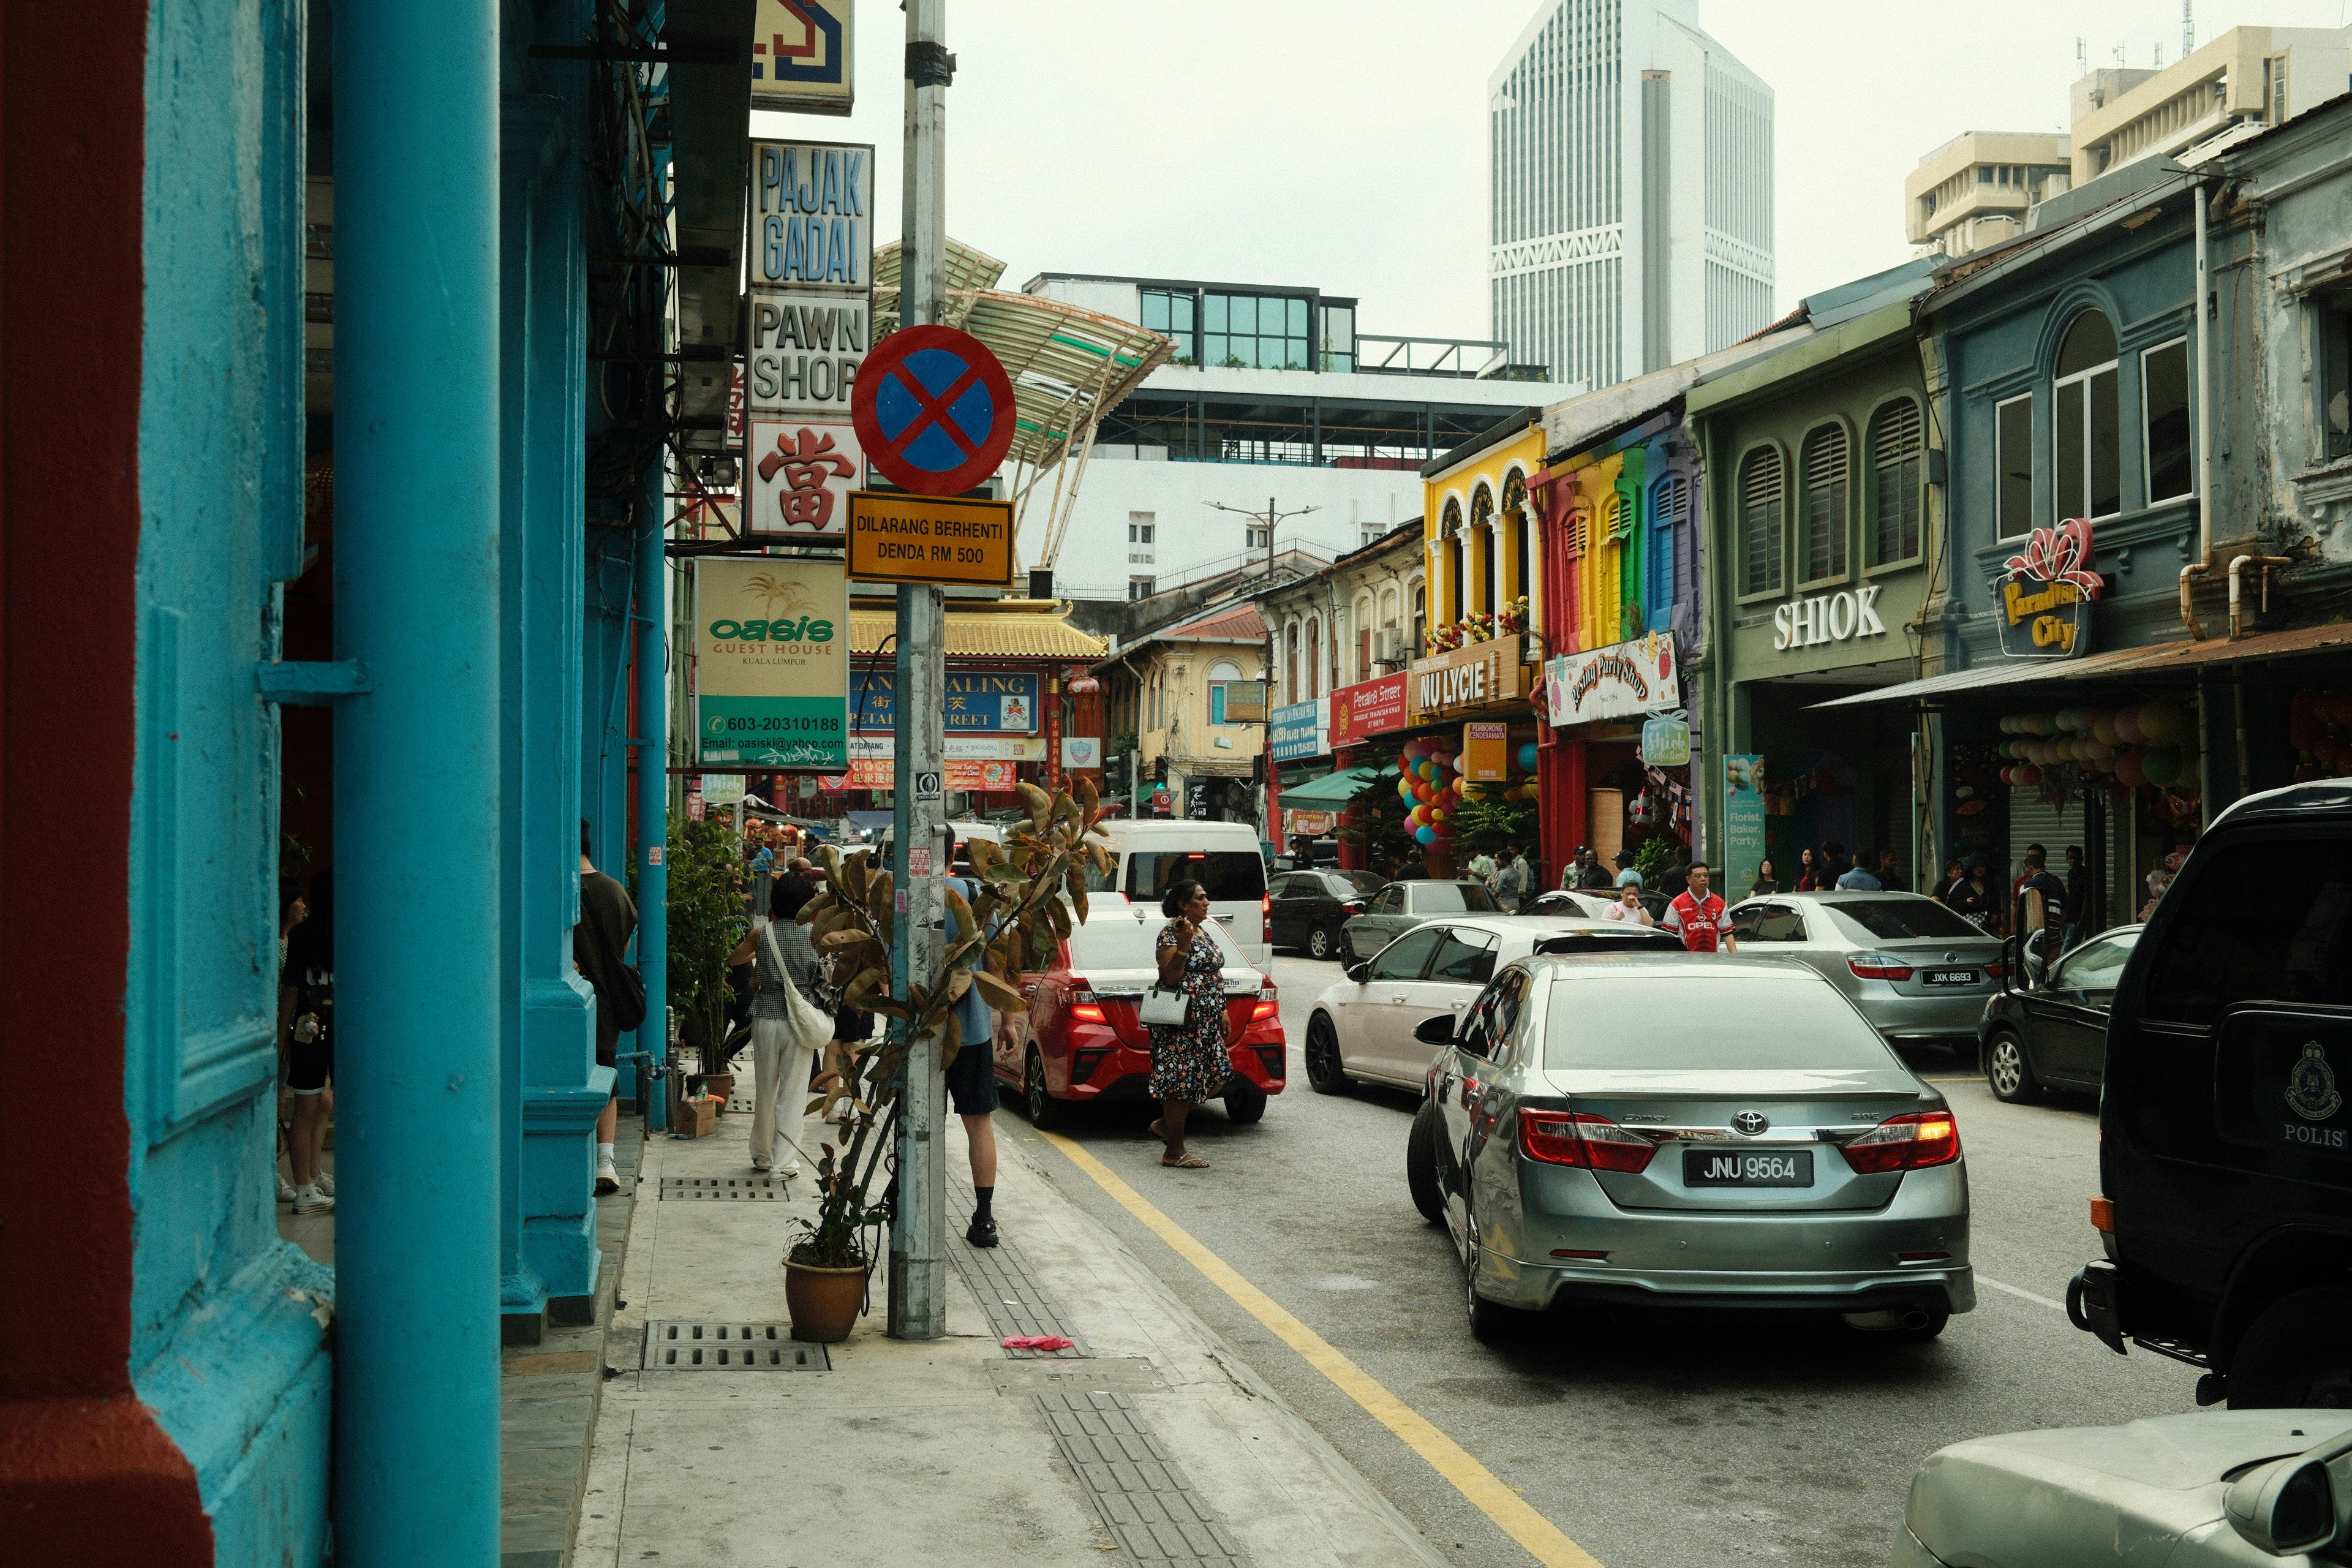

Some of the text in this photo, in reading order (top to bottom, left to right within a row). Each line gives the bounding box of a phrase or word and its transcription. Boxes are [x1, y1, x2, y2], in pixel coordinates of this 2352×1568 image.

[760, 147, 864, 216] PAJAK
[764, 216, 858, 283] GADAI
[754, 303, 864, 352] PAWN
[754, 354, 862, 402] SHOP
[758, 427, 856, 530] 當
[857, 516, 1003, 539] DILARANG BERHENTI
[878, 543, 984, 564] DENDA RM 500
[2003, 582, 2082, 627] Paradise
[709, 616, 834, 642] oasis
[1774, 585, 1887, 650] SHIOK
[2032, 615, 2075, 649] City
[713, 643, 832, 655] GUEST HOUSE
[1420, 671, 1440, 708] NU
[1443, 660, 1484, 704] LYCIE
[1597, 656, 1622, 684] Party
[1623, 660, 1647, 698] Shop
[1354, 684, 1401, 709] Petaling Street
[728, 717, 839, 731] 603-20310188
[701, 737, 843, 750] Email: oasiskl@yahoo.com
[1730, 812, 1762, 821] Florist.
[1730, 824, 1760, 833] Baker.
[1730, 837, 1760, 848] Party.
[1687, 922, 1716, 930] OPEL
[1932, 973, 1971, 982] JXK 6693
[2284, 1124, 2343, 1148] POLIS
[1703, 1157, 1795, 1178] JNU 9564
